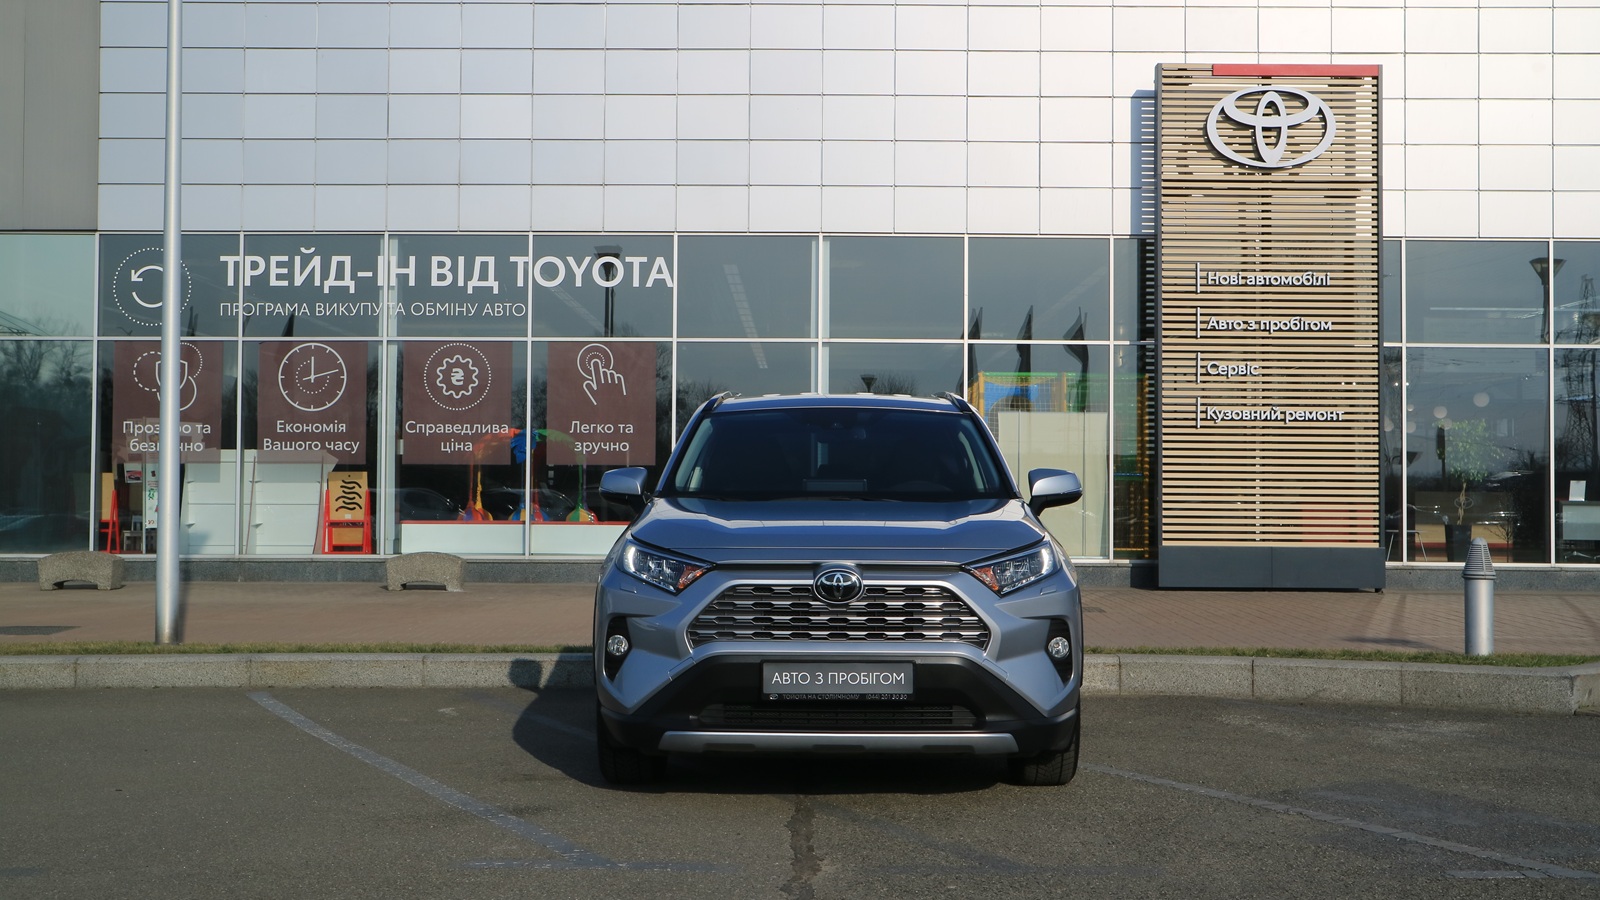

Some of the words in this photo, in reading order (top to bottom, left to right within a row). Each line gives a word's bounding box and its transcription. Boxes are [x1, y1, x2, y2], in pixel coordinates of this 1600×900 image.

[219, 247, 416, 294] ТРЕЙД-ІН
[430, 255, 499, 294] ВІД
[509, 255, 674, 288] TOYOTA
[1207, 271, 1242, 285] Нові
[1246, 271, 1331, 286] автомобілі
[220, 302, 311, 317] ПРОГРАМА
[315, 302, 383, 317] ВИКУПУ
[387, 302, 406, 317] ТА
[410, 302, 479, 317] ОБМІНУ
[482, 302, 527, 317] АВТО
[1207, 316, 1244, 330] Авто
[1247, 319, 1257, 331] з
[1260, 316, 1332, 334] пробігом
[1207, 361, 1260, 379] Сервіс
[1206, 406, 1281, 423] Кузовний
[1285, 410, 1345, 424] ремонт
[122, 421, 192, 437] Прозо
[195, 424, 211, 434] та
[276, 420, 347, 433] Економія
[405, 420, 509, 436] Справедлива
[569, 420, 614, 434] Легко
[618, 423, 634, 434] та
[129, 438, 204, 452] безно
[263, 438, 322, 451] Вашого
[325, 441, 360, 454] часу
[440, 439, 473, 453] ціна
[574, 441, 629, 455] зручно
[771, 672, 811, 685] АВТО
[814, 672, 824, 685] З
[828, 672, 905, 685] ПРОБІГОМ
